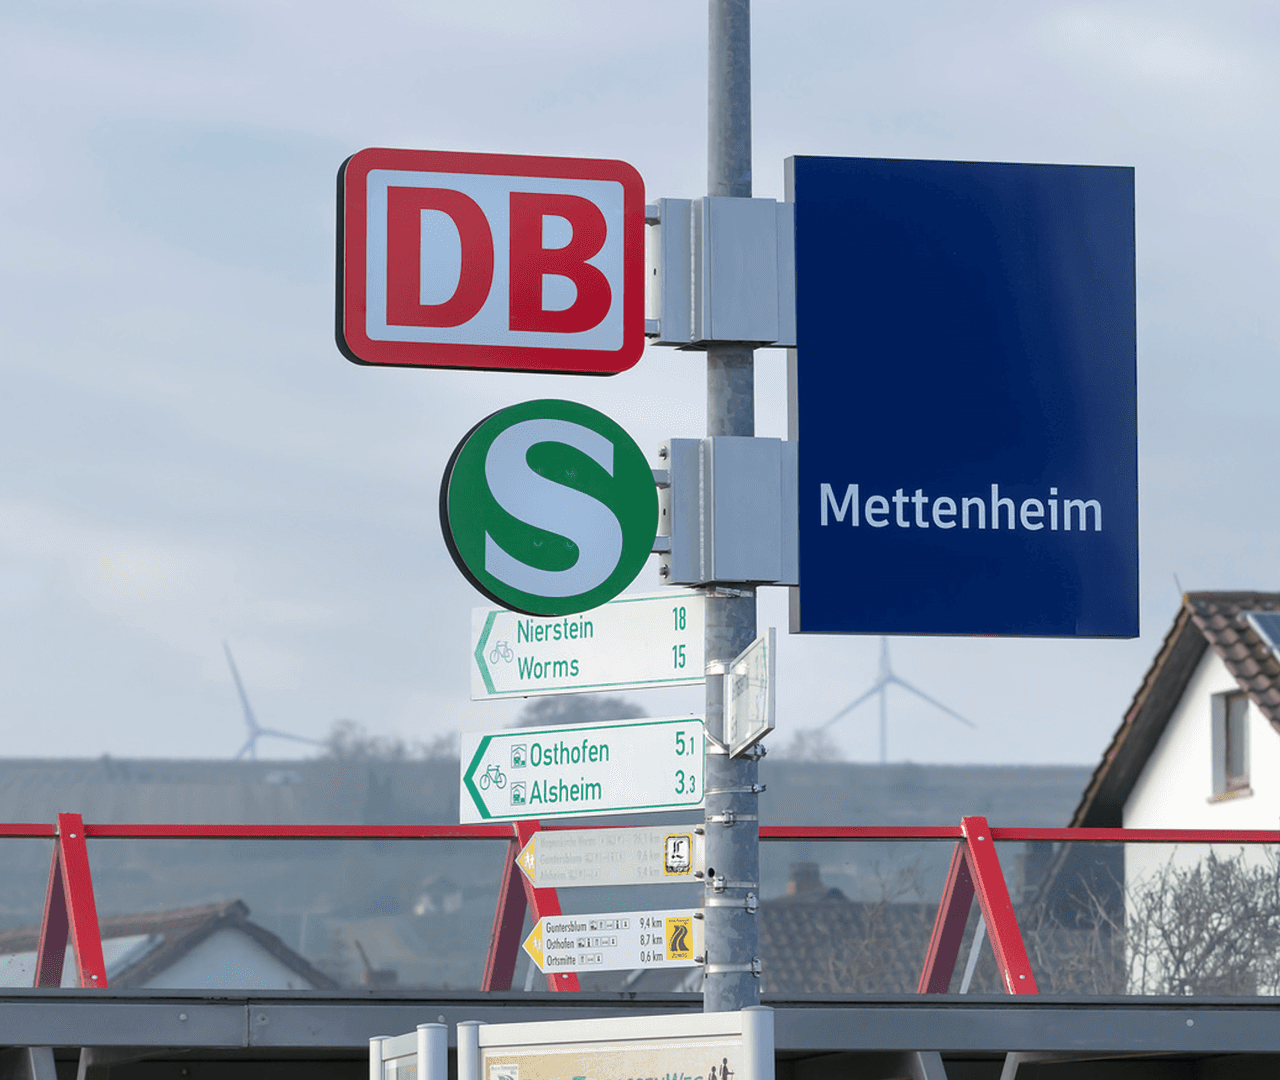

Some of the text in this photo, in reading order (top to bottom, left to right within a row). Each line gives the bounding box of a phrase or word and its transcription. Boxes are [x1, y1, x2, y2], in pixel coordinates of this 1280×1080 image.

[386, 186, 612, 333] DB
[482, 418, 623, 597] S
[820, 483, 1102, 532] Mettenheim
[517, 606, 686, 644] Nierstein 18
[517, 644, 686, 680] Worms 15
[530, 739, 609, 767] Osthofen
[529, 776, 602, 805] Alsheim
[546, 920, 587, 933] Guntersblum
[640, 917, 650, 930] 9,4
[651, 917, 663, 928] km
[546, 933, 663, 949] Osthofen 8,7 km
[546, 950, 664, 967] Ortsmitte 0,6 km
